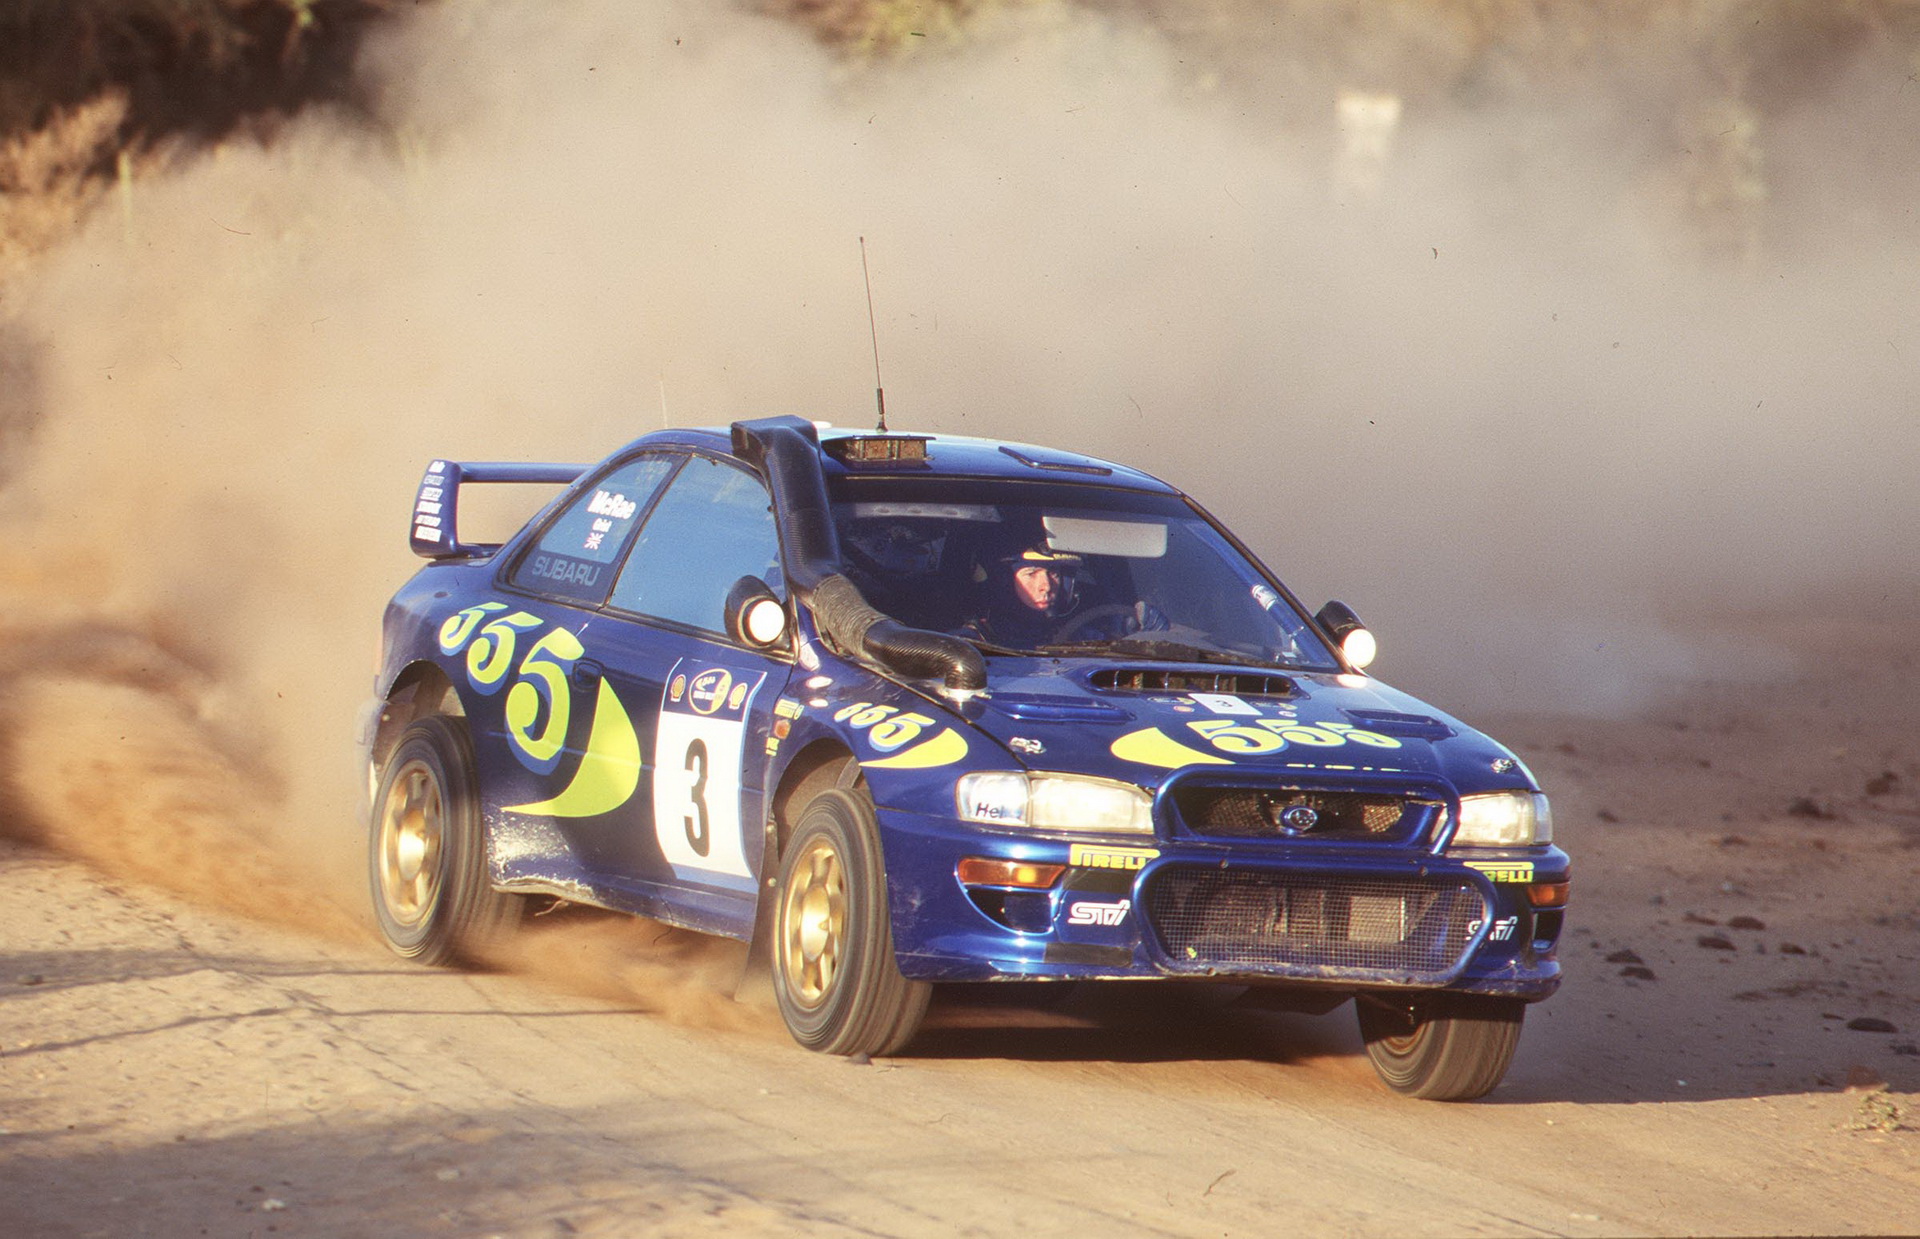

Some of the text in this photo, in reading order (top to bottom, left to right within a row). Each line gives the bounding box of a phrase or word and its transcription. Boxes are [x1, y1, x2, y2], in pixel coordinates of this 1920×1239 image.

[532, 556, 600, 587] SUBARU
[439, 601, 585, 770] 555
[834, 702, 937, 751] 555
[1186, 718, 1403, 755] 555
[683, 738, 710, 858] 3
[1069, 843, 1161, 870] PIRELL
